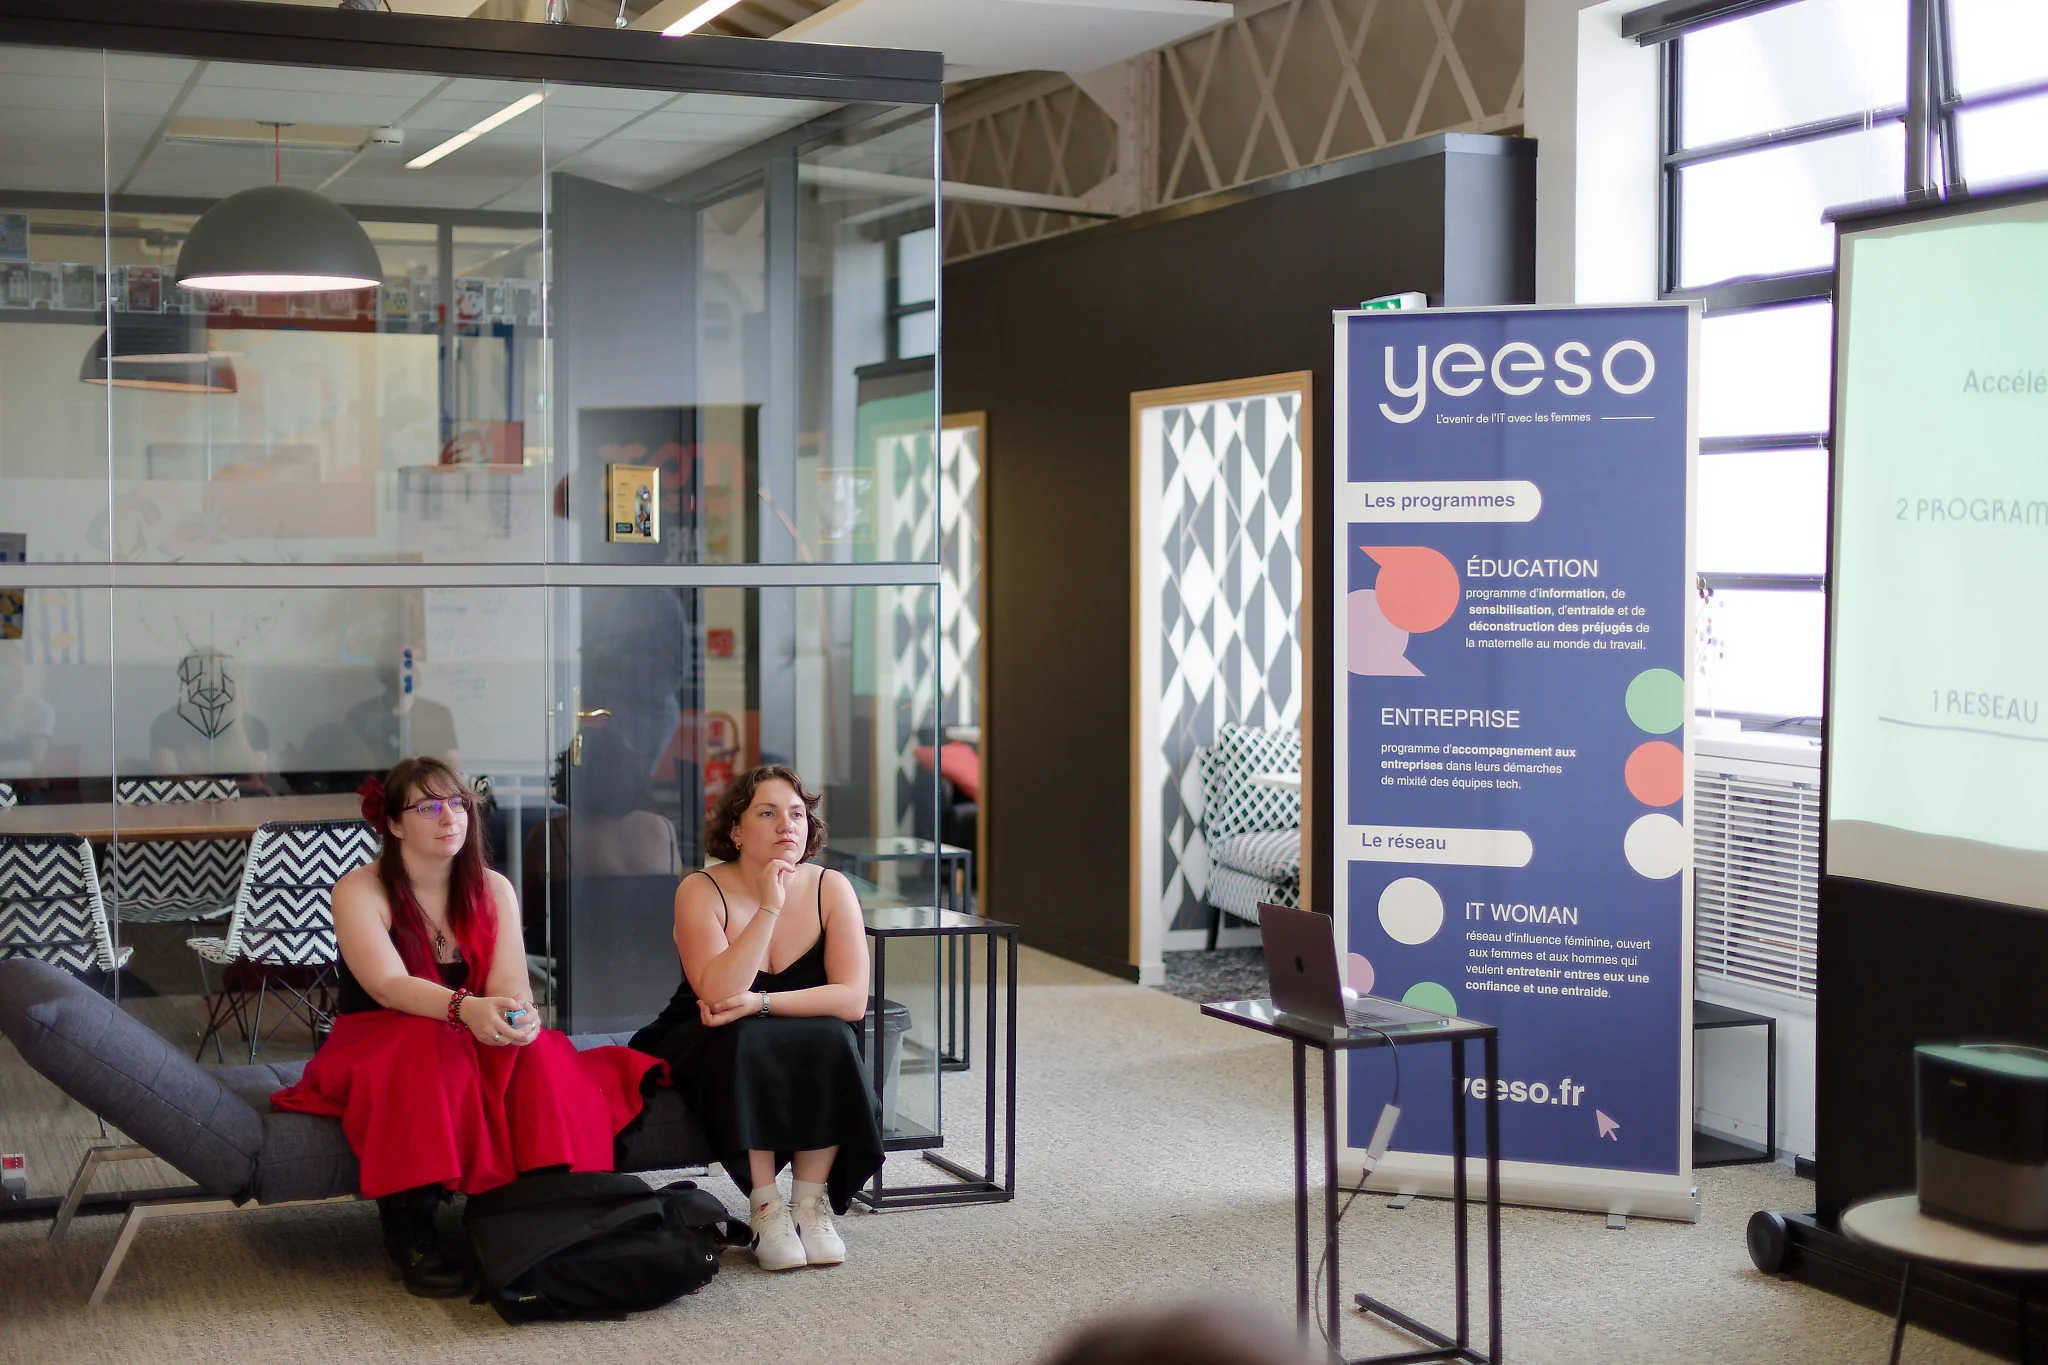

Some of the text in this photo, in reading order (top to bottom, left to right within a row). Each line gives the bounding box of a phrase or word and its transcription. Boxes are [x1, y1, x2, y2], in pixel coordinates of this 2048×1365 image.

[1378, 339, 1655, 424] yeeso
[1963, 368, 2048, 394] Accélé
[1475, 412, 1489, 424] de
[1506, 414, 1533, 424] avec
[1534, 412, 1549, 423] les
[1550, 411, 1591, 423] femmes
[1363, 491, 1516, 512] Les programmes
[1896, 498, 2048, 525] 2 PROGRAM
[1466, 554, 1599, 578] ÉDUCATION
[1465, 587, 1627, 601] programme d'information, de
[1468, 604, 1556, 617] sensibilisation,
[1616, 605, 1629, 616] et
[1630, 605, 1646, 616] de
[1468, 620, 1651, 636] déconstruction des préjugés de
[1465, 637, 1647, 650] la maternelle au monde du travail.
[1947, 690, 2038, 724] RESEAU
[1380, 706, 1521, 729] ENTREPRISE
[1380, 742, 1440, 757] programme
[1554, 747, 1577, 758] aux
[1380, 759, 1563, 775] entreprises dans leurs démarches
[1380, 774, 1522, 791] de mixité des équipes tech.
[1361, 832, 1447, 851] Le réseau
[1464, 901, 1579, 926] IT WOMAN
[1465, 930, 1503, 943] réseau
[1563, 935, 1614, 950] féminine,
[1615, 939, 1651, 950] ouvert
[1468, 947, 1638, 968] aux femmes et aux hommes qui
[1464, 964, 1650, 984] veulent entretenir entres eux une
[1464, 979, 1612, 999] confiance et une entraide.
[1462, 1077, 1585, 1106] eeso.fr
